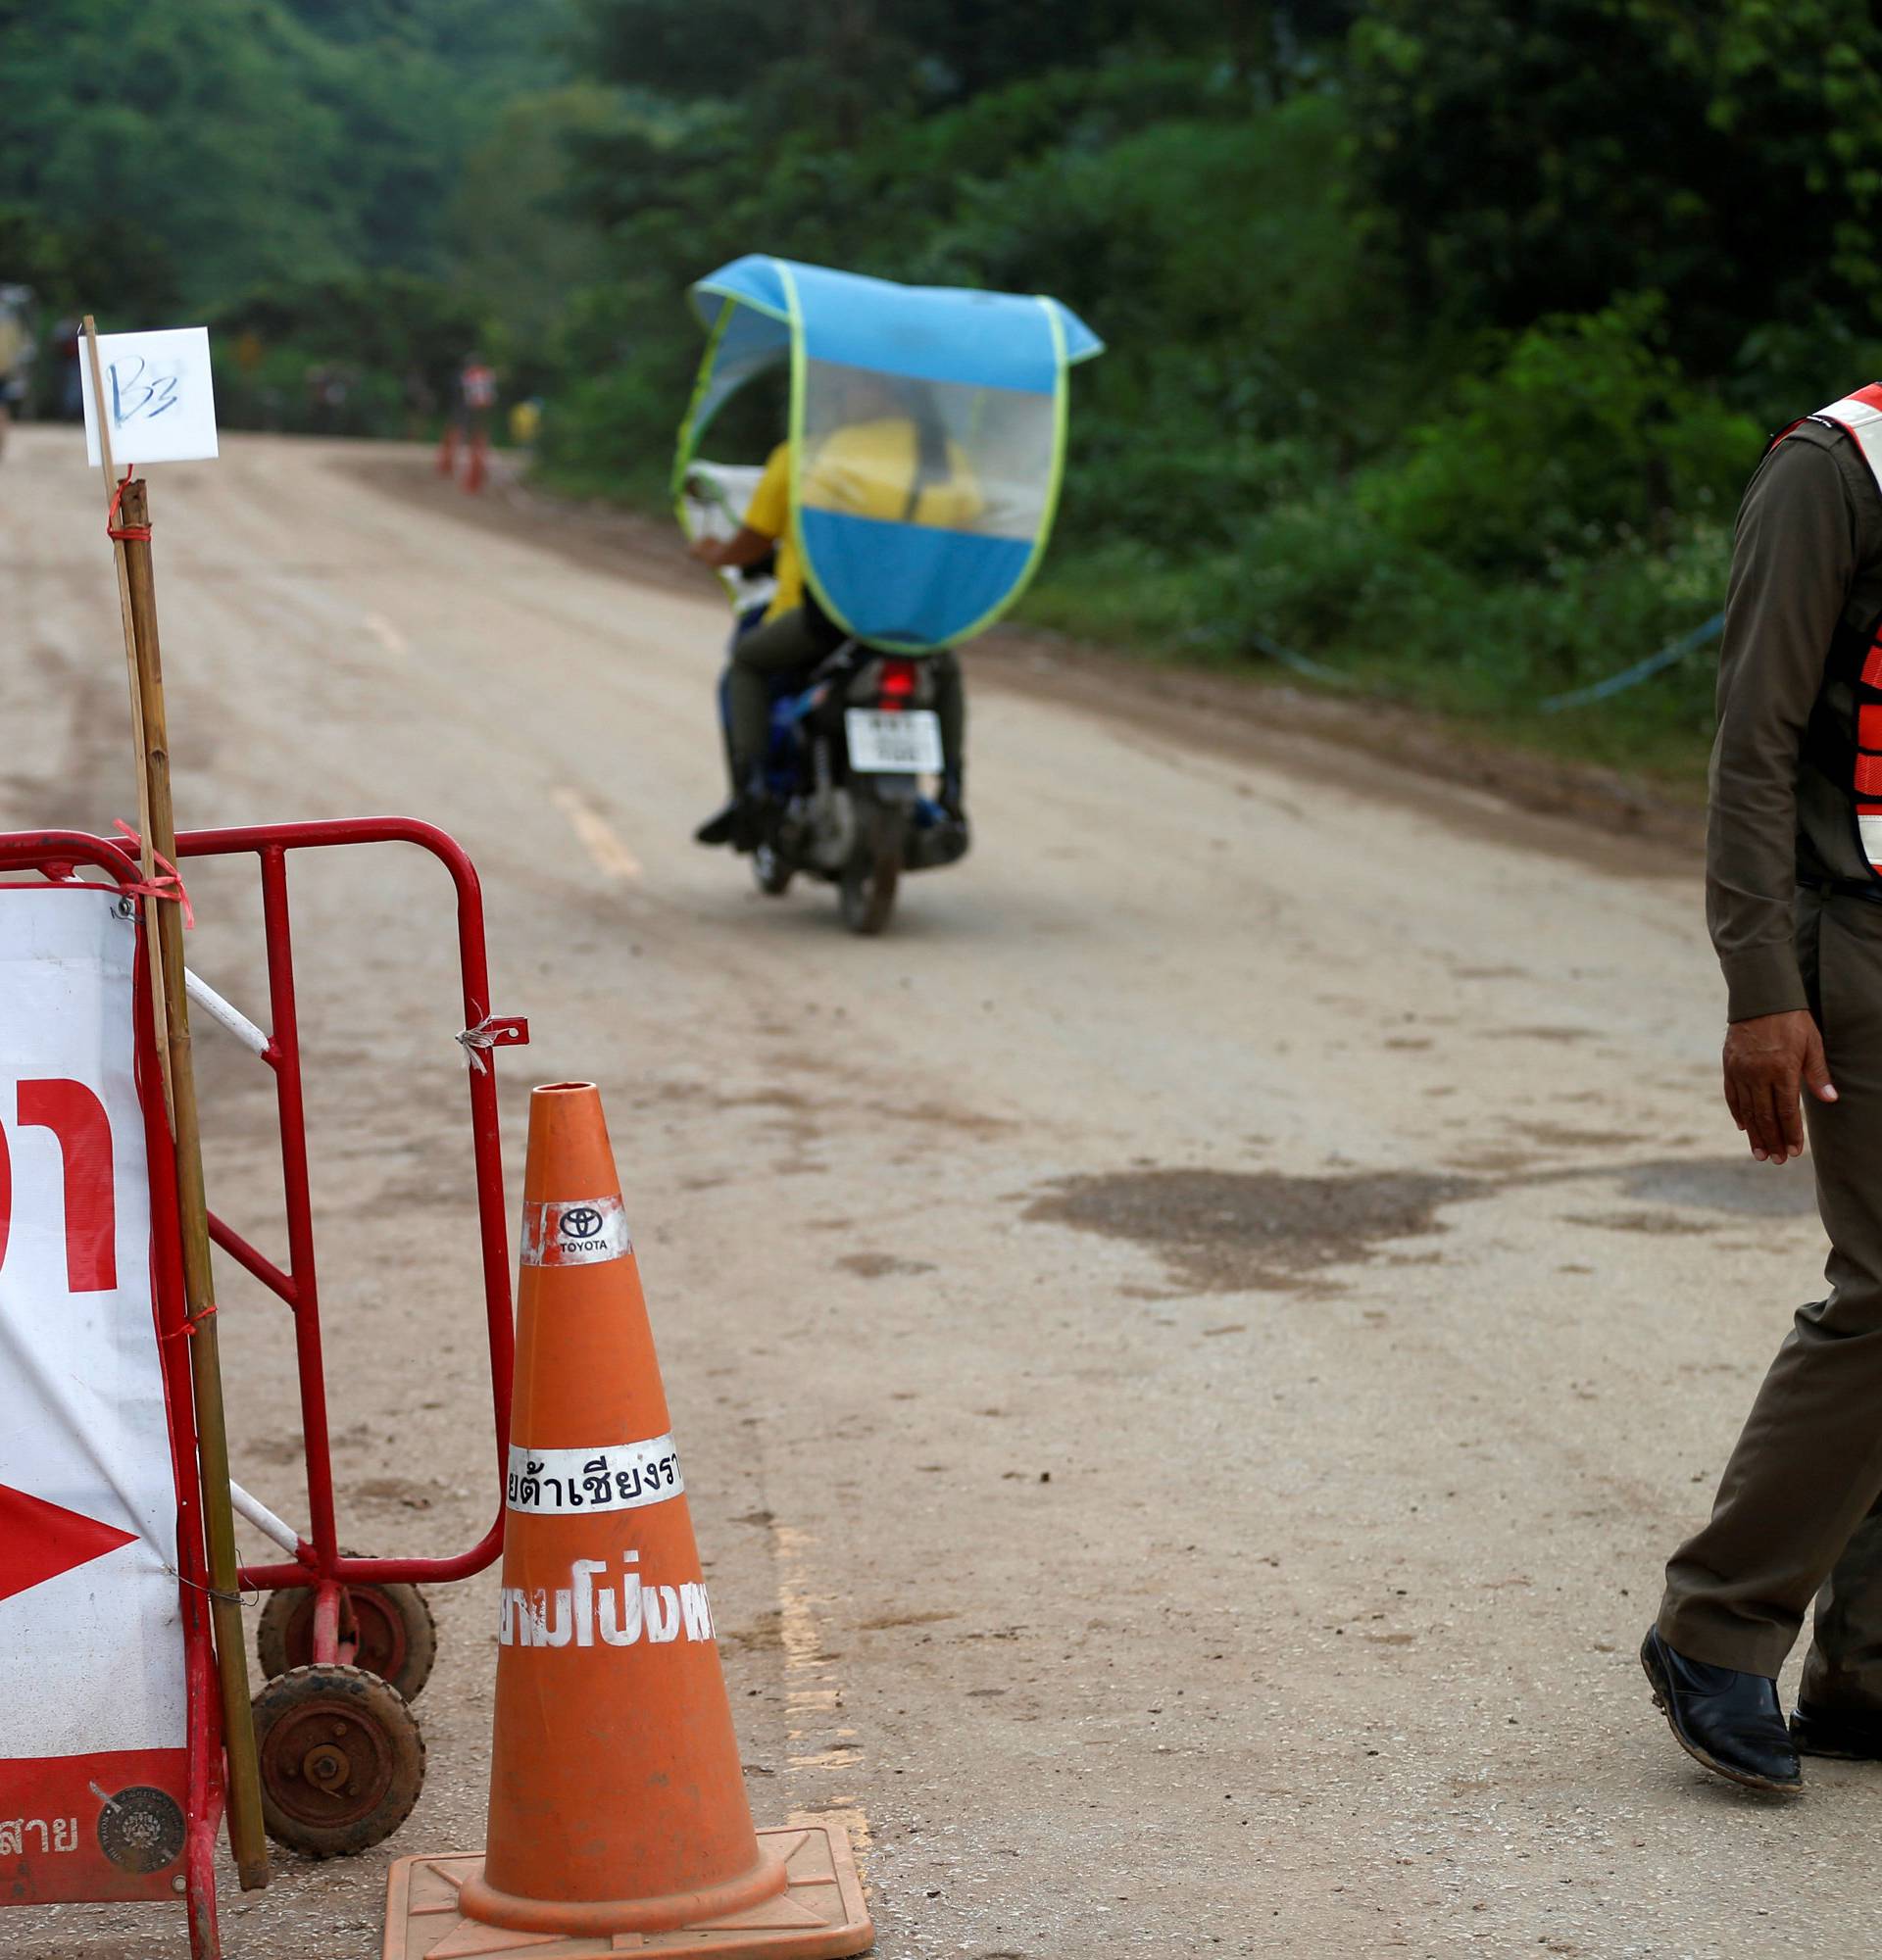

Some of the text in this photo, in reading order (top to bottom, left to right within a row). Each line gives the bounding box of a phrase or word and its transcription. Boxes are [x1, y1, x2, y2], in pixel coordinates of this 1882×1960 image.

[106, 354, 177, 429] B3
[0, 1077, 118, 1294] า
[560, 1240, 608, 1253] TOYOTA
